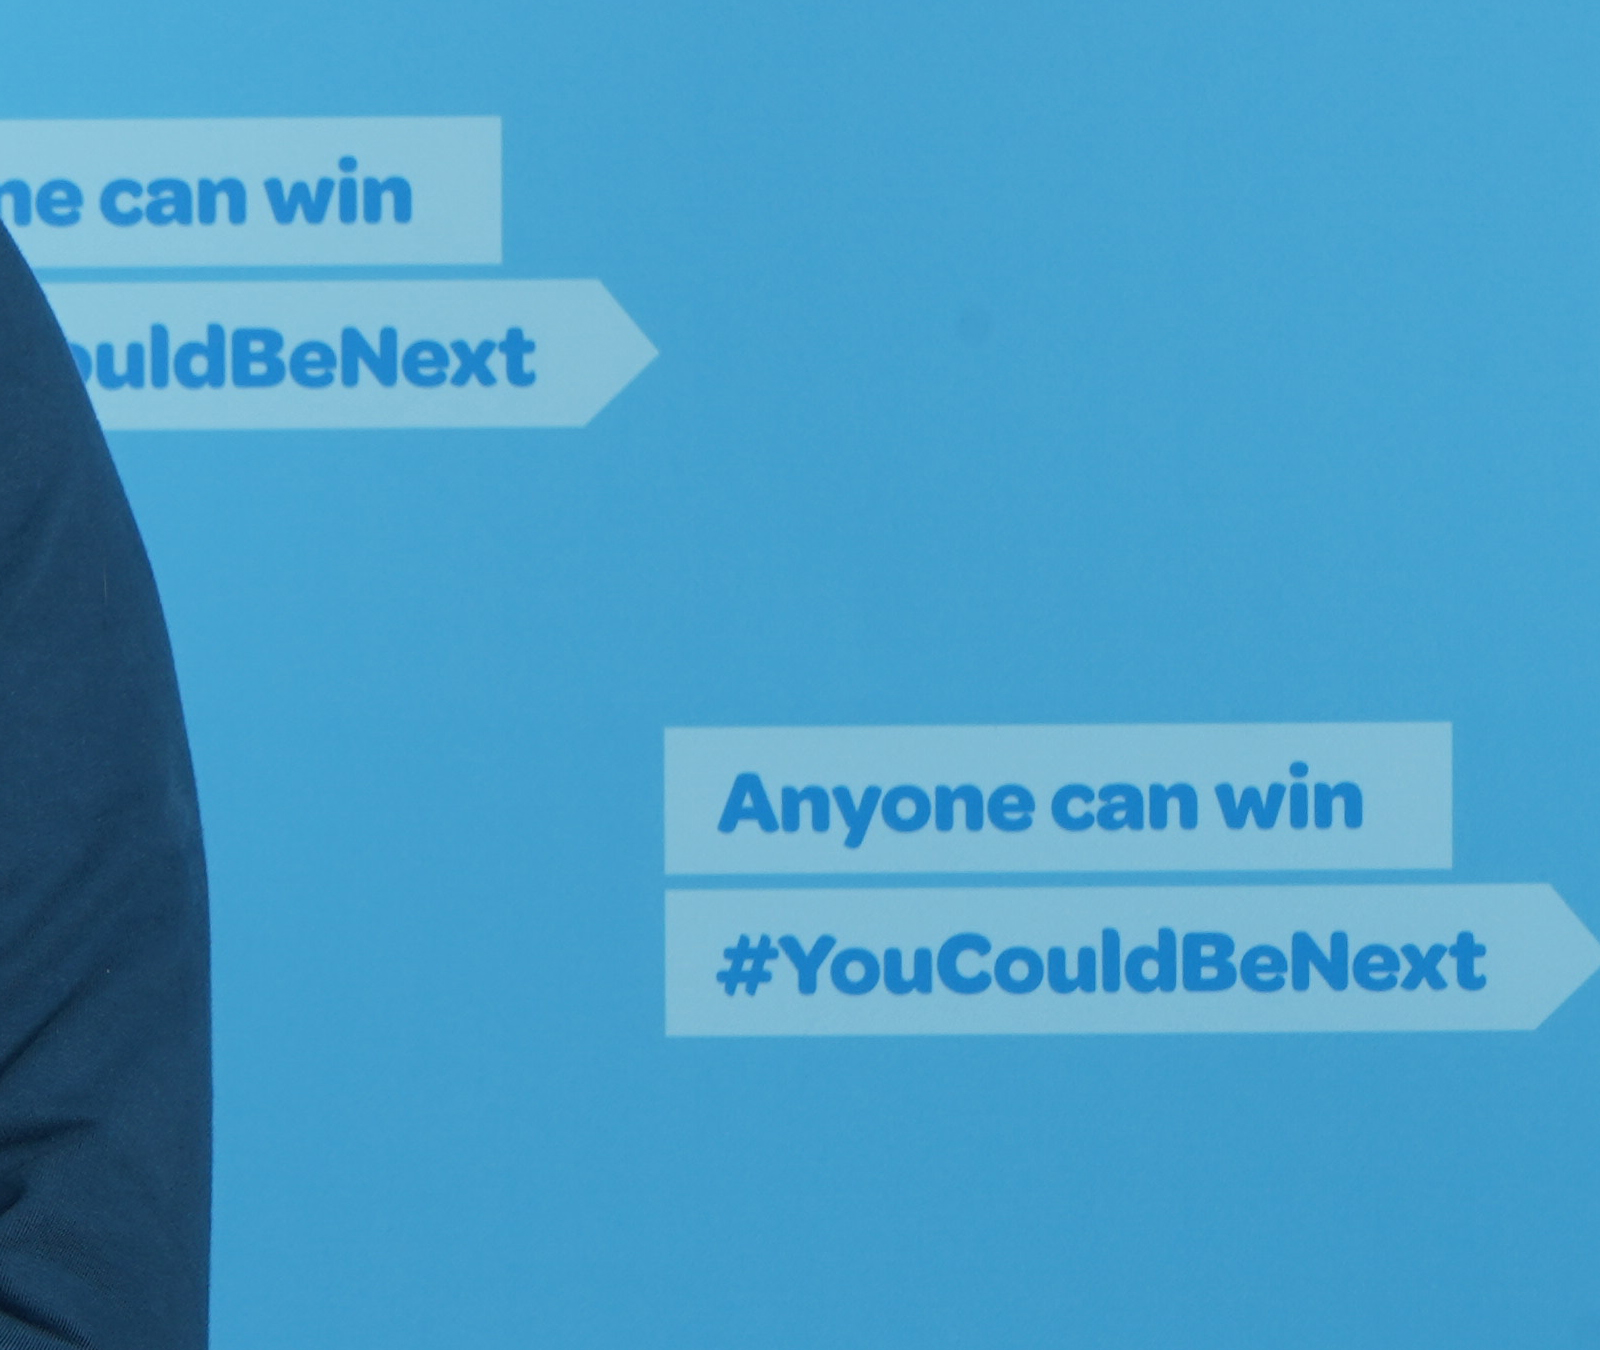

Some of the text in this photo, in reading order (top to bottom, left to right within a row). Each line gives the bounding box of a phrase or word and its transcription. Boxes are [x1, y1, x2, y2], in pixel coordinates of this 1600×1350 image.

[100, 177, 247, 226] can
[264, 155, 412, 224] win
[67, 323, 536, 390] uldBeNext
[718, 761, 1363, 849] Anyone can win
[717, 927, 1487, 995] #YouCouldBeNext
